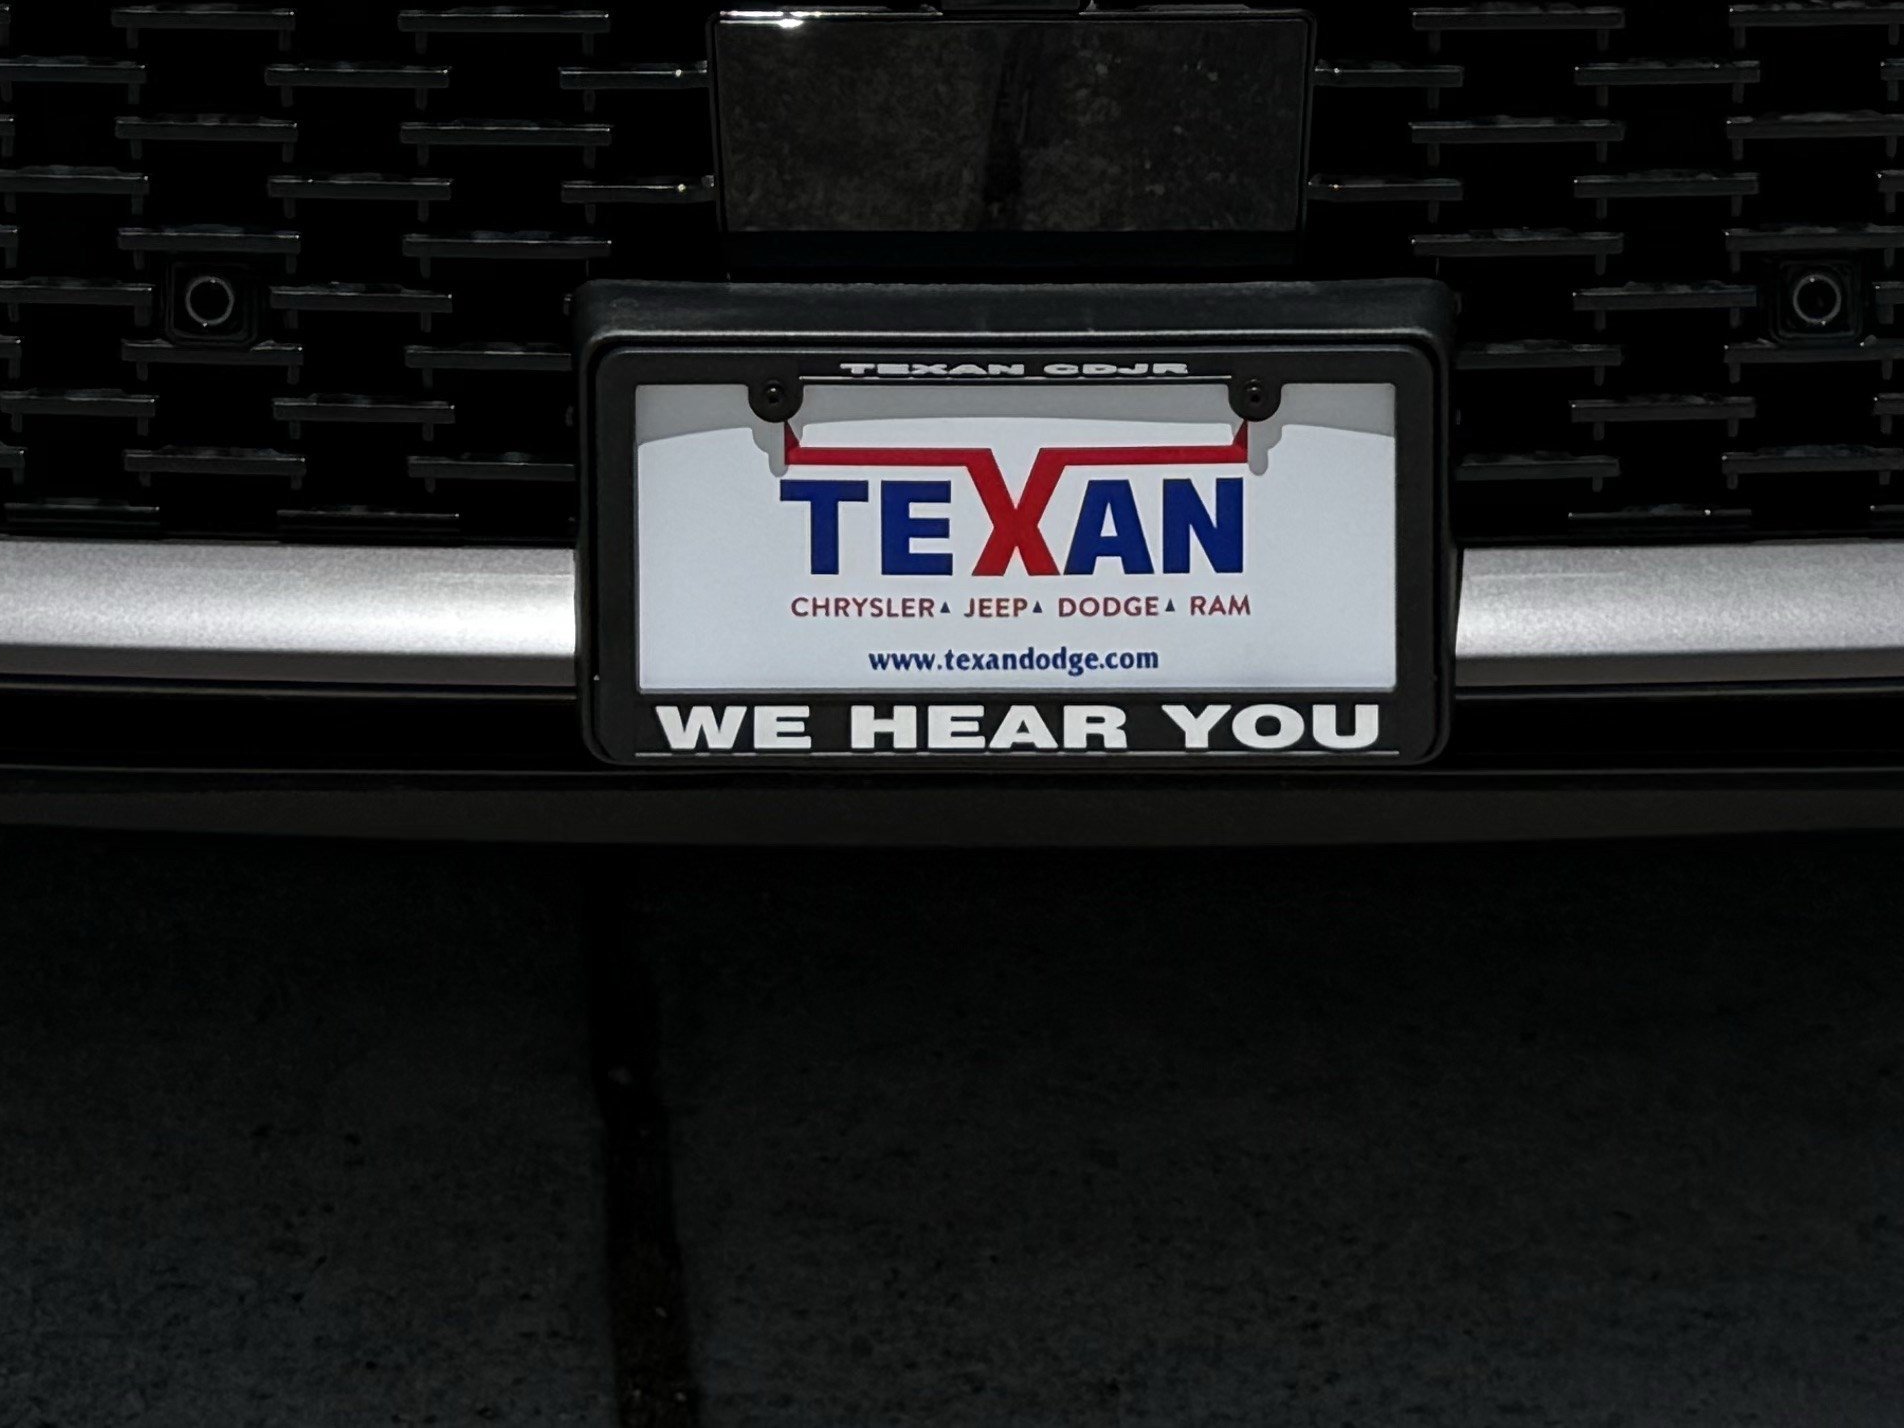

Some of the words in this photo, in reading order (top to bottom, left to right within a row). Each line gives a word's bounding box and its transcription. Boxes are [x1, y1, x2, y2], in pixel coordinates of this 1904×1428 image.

[840, 363, 1025, 375] TEXAN
[1043, 363, 1188, 375] CDJR
[780, 448, 1244, 577] TEXAN
[790, 597, 936, 619] CHRYSLER
[963, 597, 1028, 618] JEEP
[1058, 596, 1160, 617] DODGE
[1189, 595, 1252, 617] RAM
[867, 646, 1160, 677] www.texandodge.com
[655, 705, 812, 751] WE
[850, 705, 1128, 751] HEAR
[1163, 703, 1381, 750] YOU
